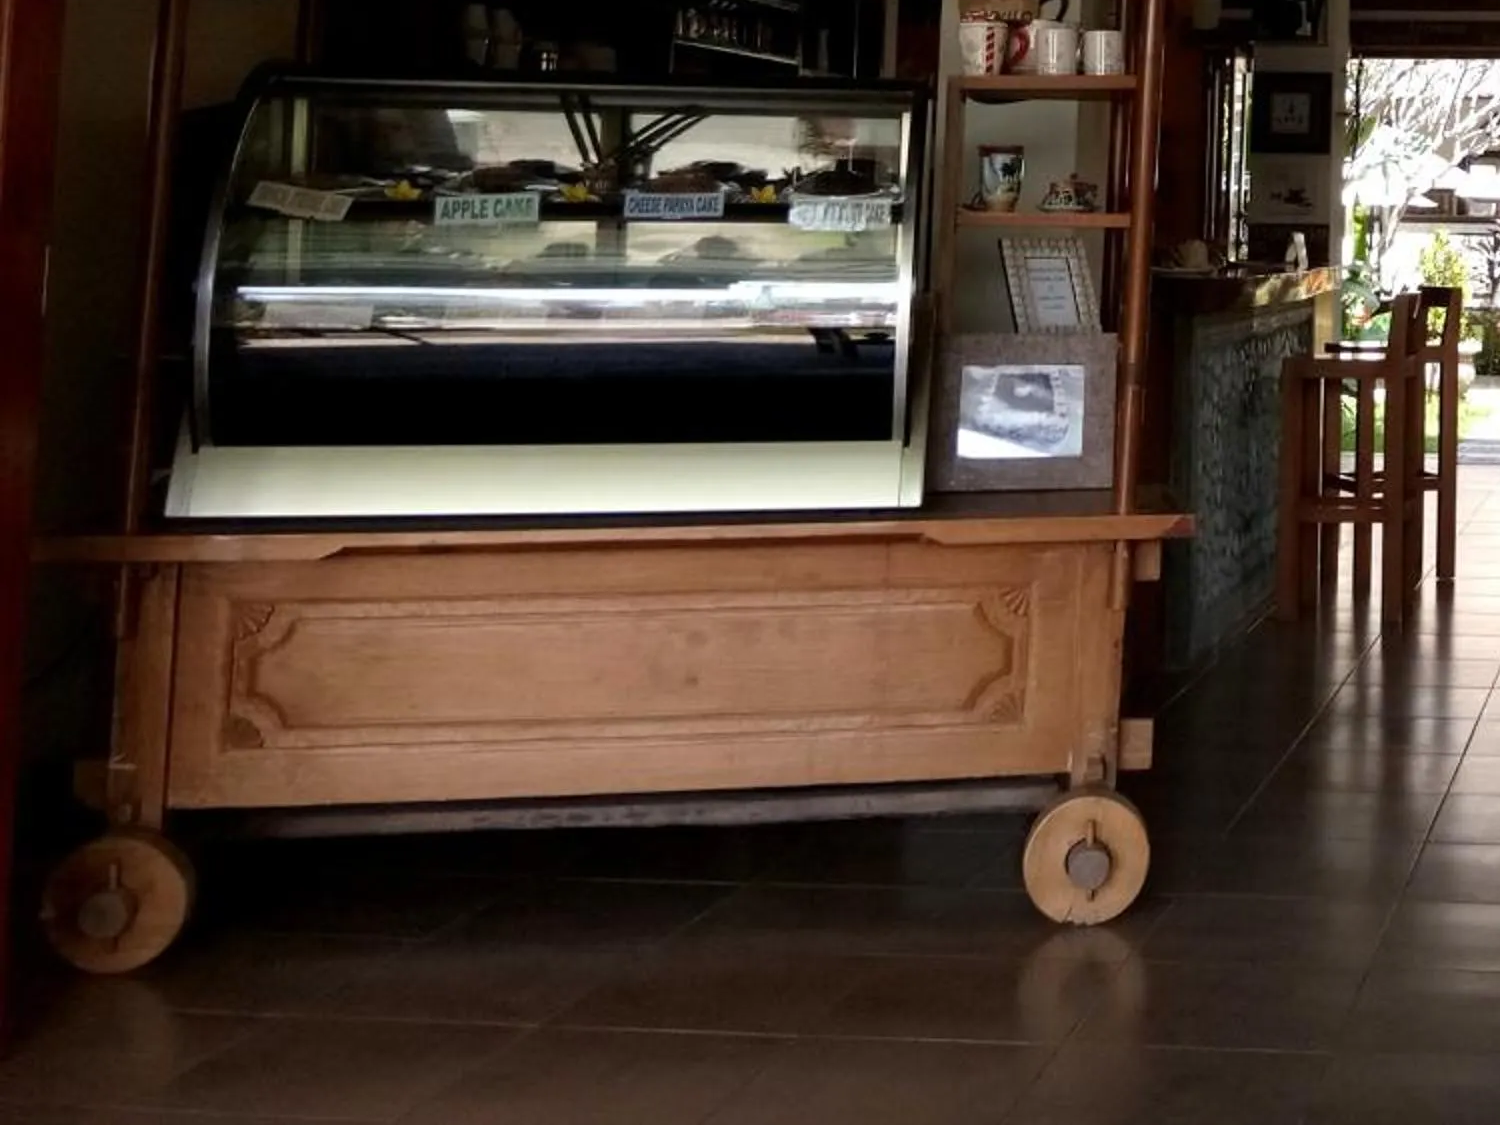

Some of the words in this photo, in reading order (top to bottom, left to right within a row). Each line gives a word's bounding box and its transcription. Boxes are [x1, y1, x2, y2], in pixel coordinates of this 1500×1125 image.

[440, 198, 489, 220] APPLE
[493, 196, 534, 218] CAKE
[695, 195, 721, 213] CAKE
